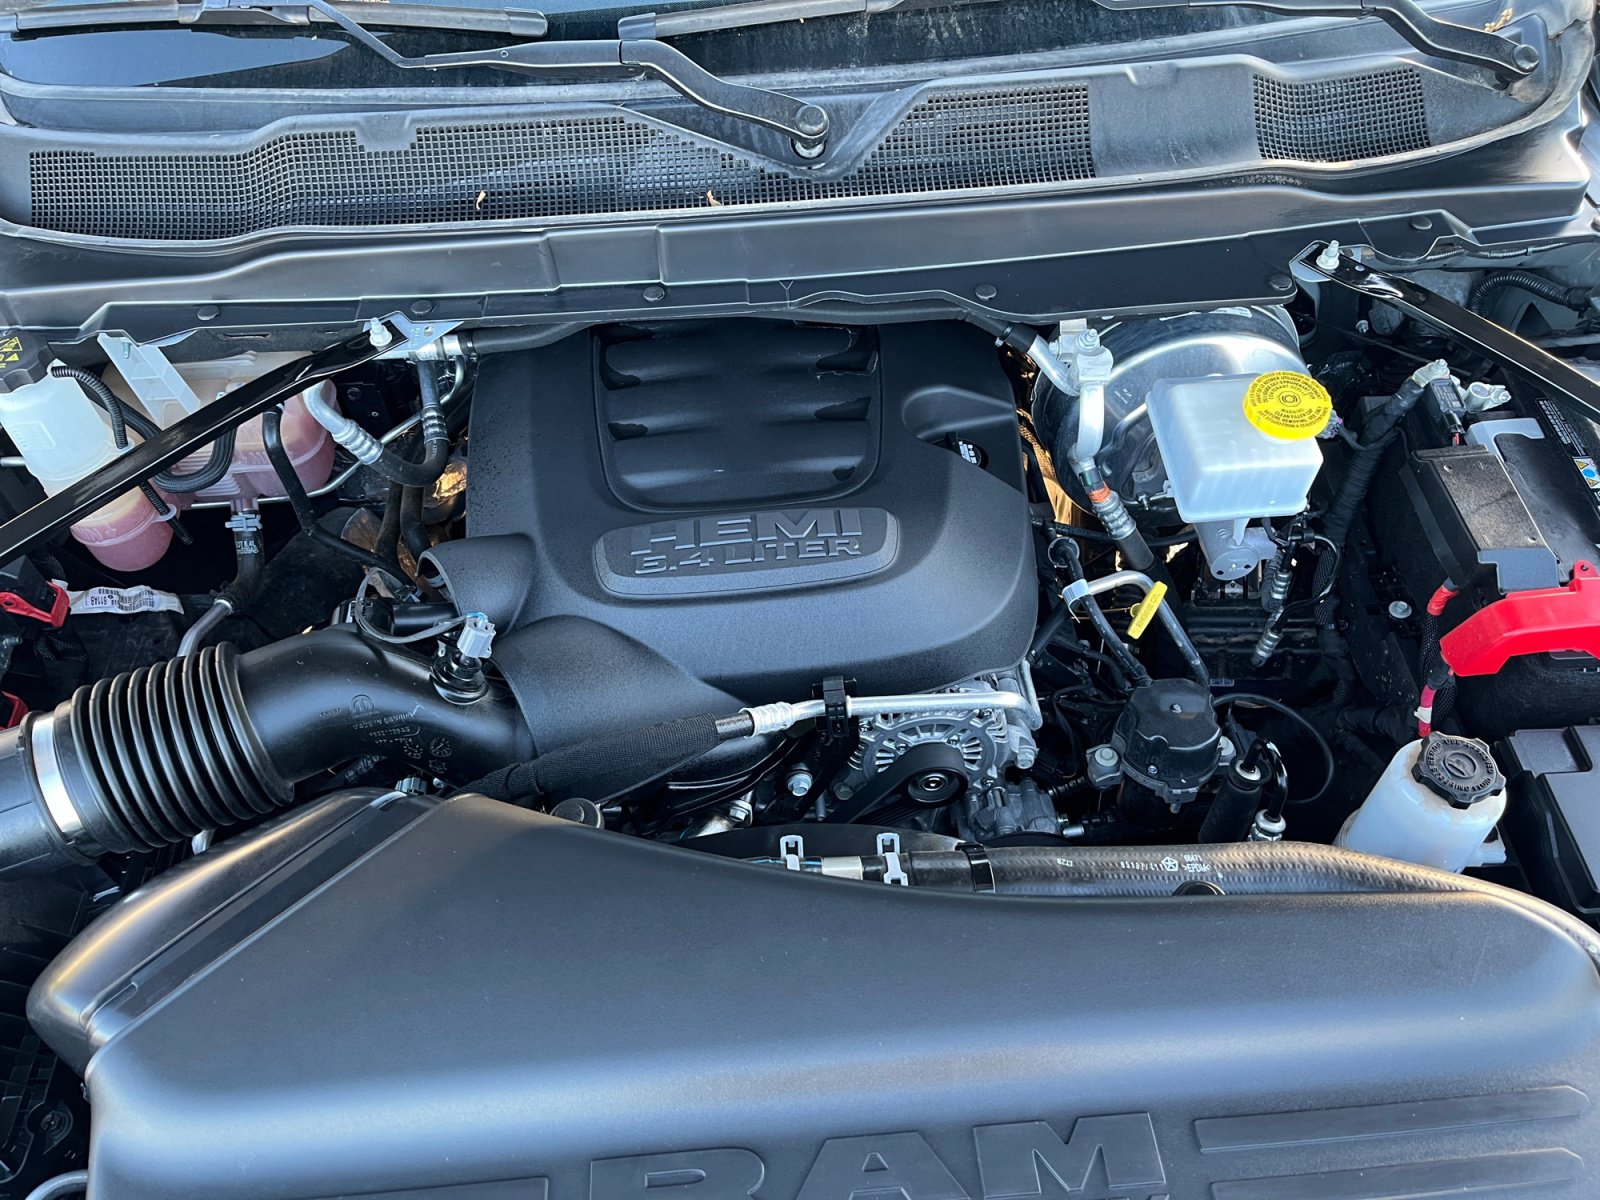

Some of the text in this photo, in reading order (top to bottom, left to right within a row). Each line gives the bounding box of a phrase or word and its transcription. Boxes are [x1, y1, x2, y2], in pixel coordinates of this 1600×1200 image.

[631, 508, 862, 555] HEMI
[724, 538, 862, 565] LITER
[590, 1111, 1167, 1200] RAM
